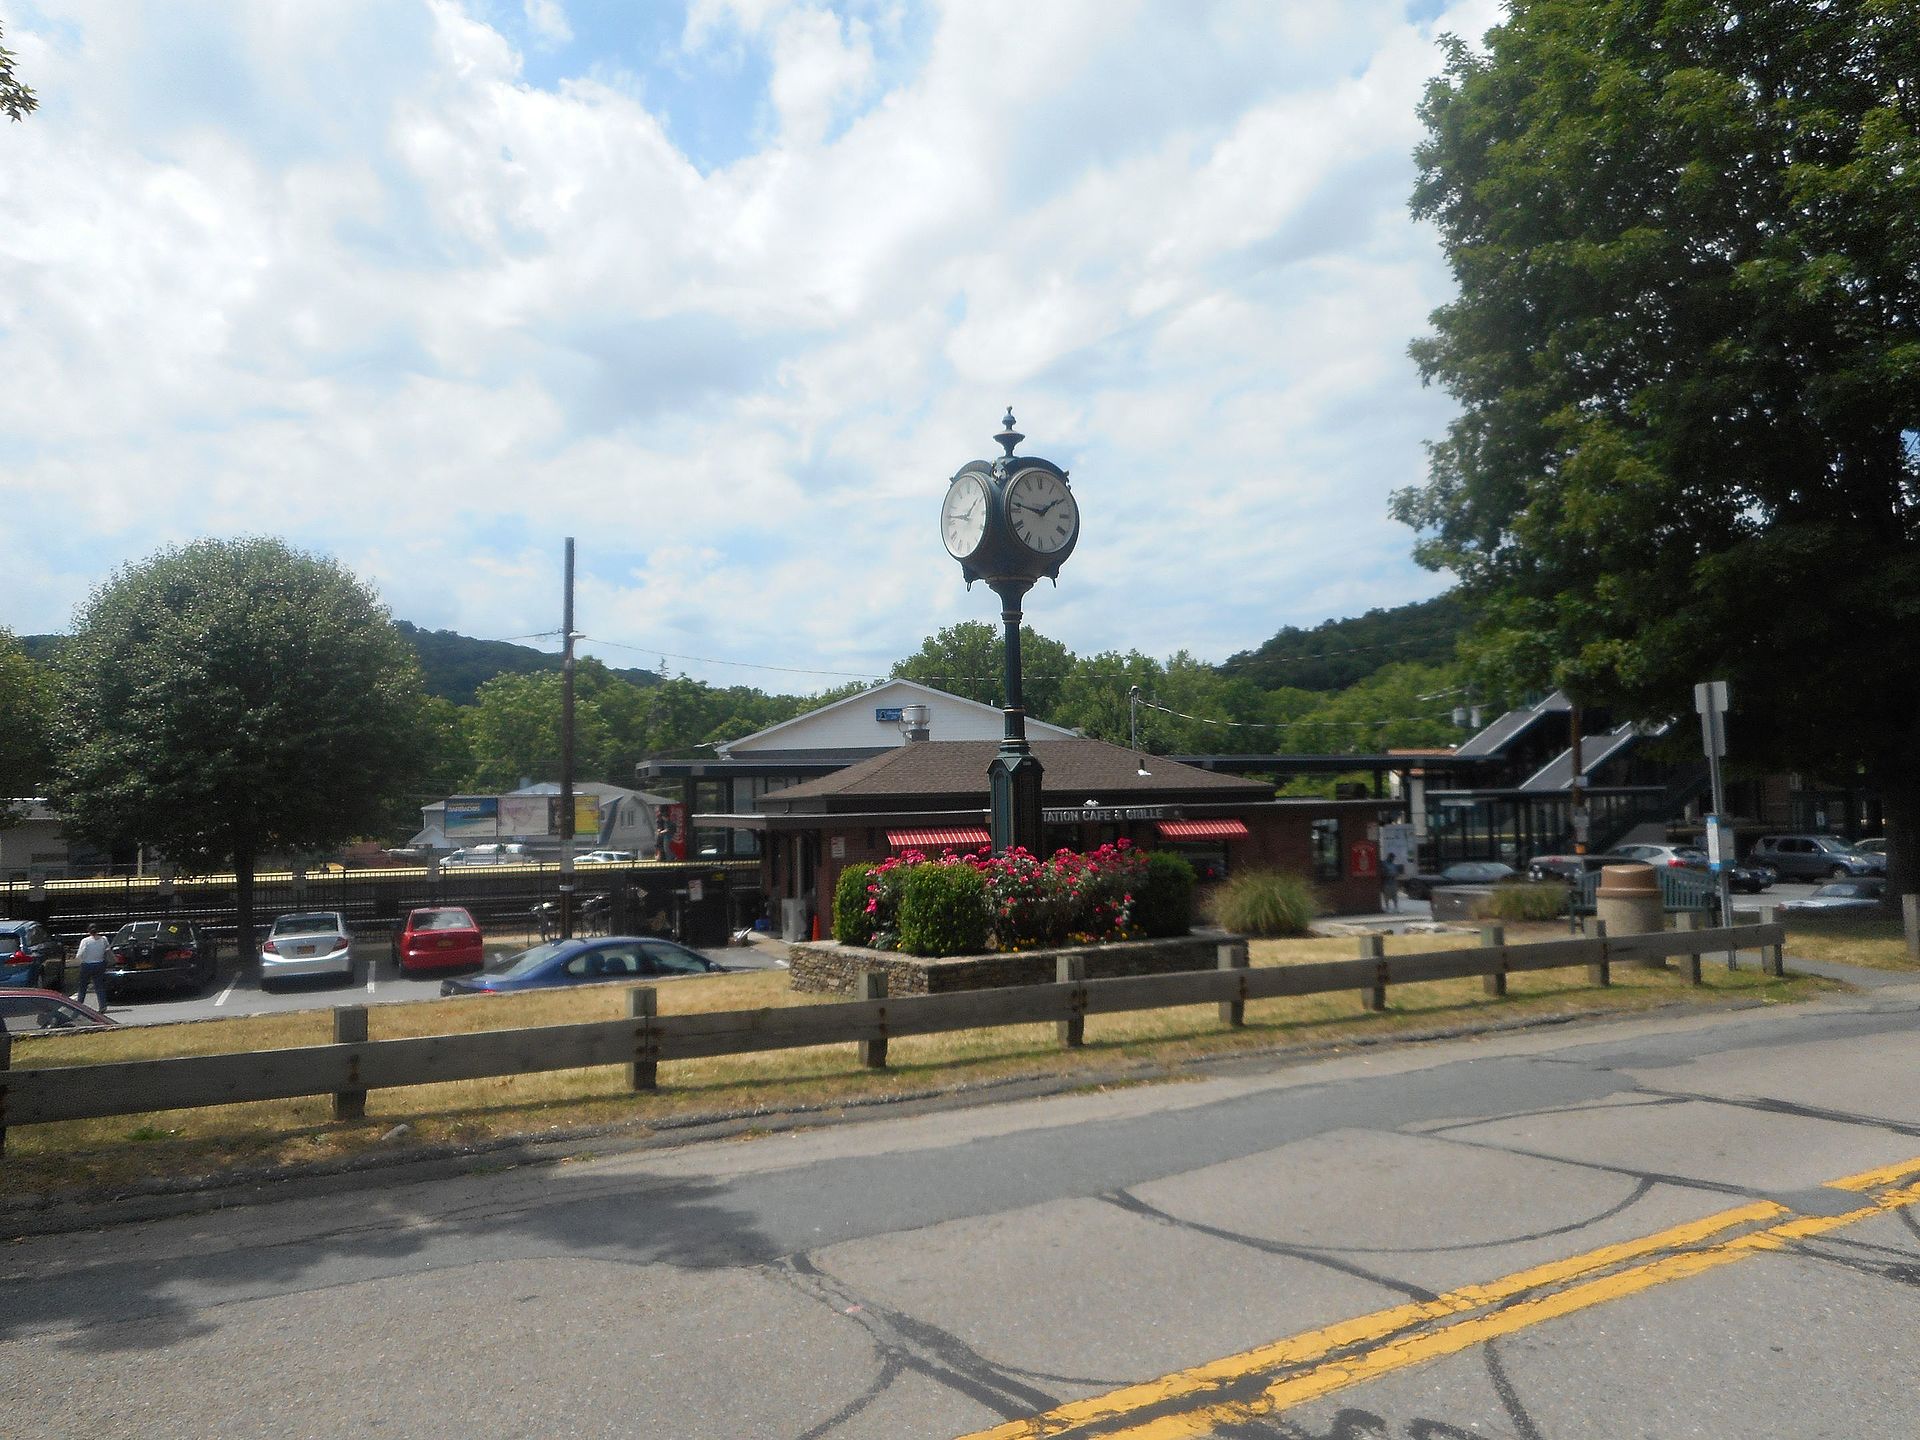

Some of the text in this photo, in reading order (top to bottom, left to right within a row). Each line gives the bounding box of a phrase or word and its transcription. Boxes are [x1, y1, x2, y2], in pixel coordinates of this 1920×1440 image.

[1042, 808, 1163, 822] TATION CAFE & GRILLE
